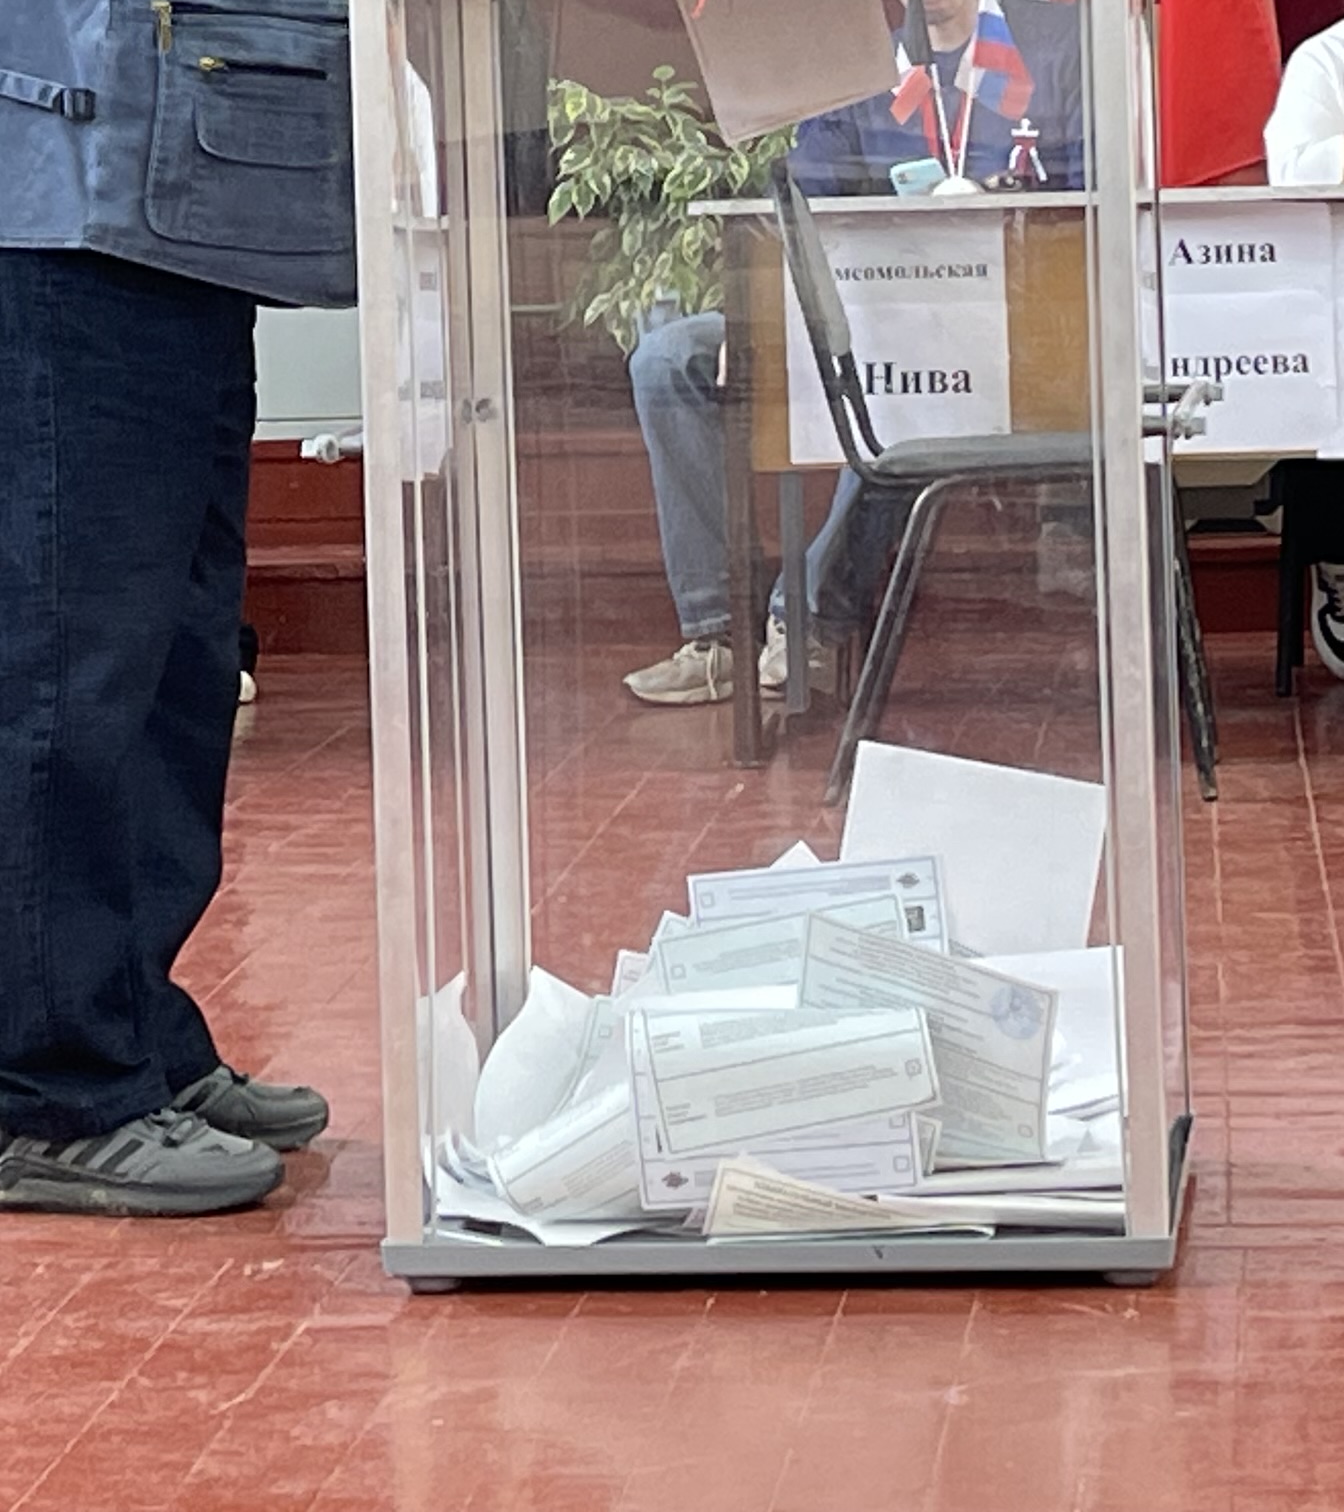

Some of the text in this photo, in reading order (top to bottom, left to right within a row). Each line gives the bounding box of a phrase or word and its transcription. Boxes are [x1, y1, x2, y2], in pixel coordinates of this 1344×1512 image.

[1168, 238, 1277, 266] Азина
[834, 263, 988, 281] мсомольская
[863, 362, 973, 395] Нива
[1171, 353, 1310, 383] ндреева
